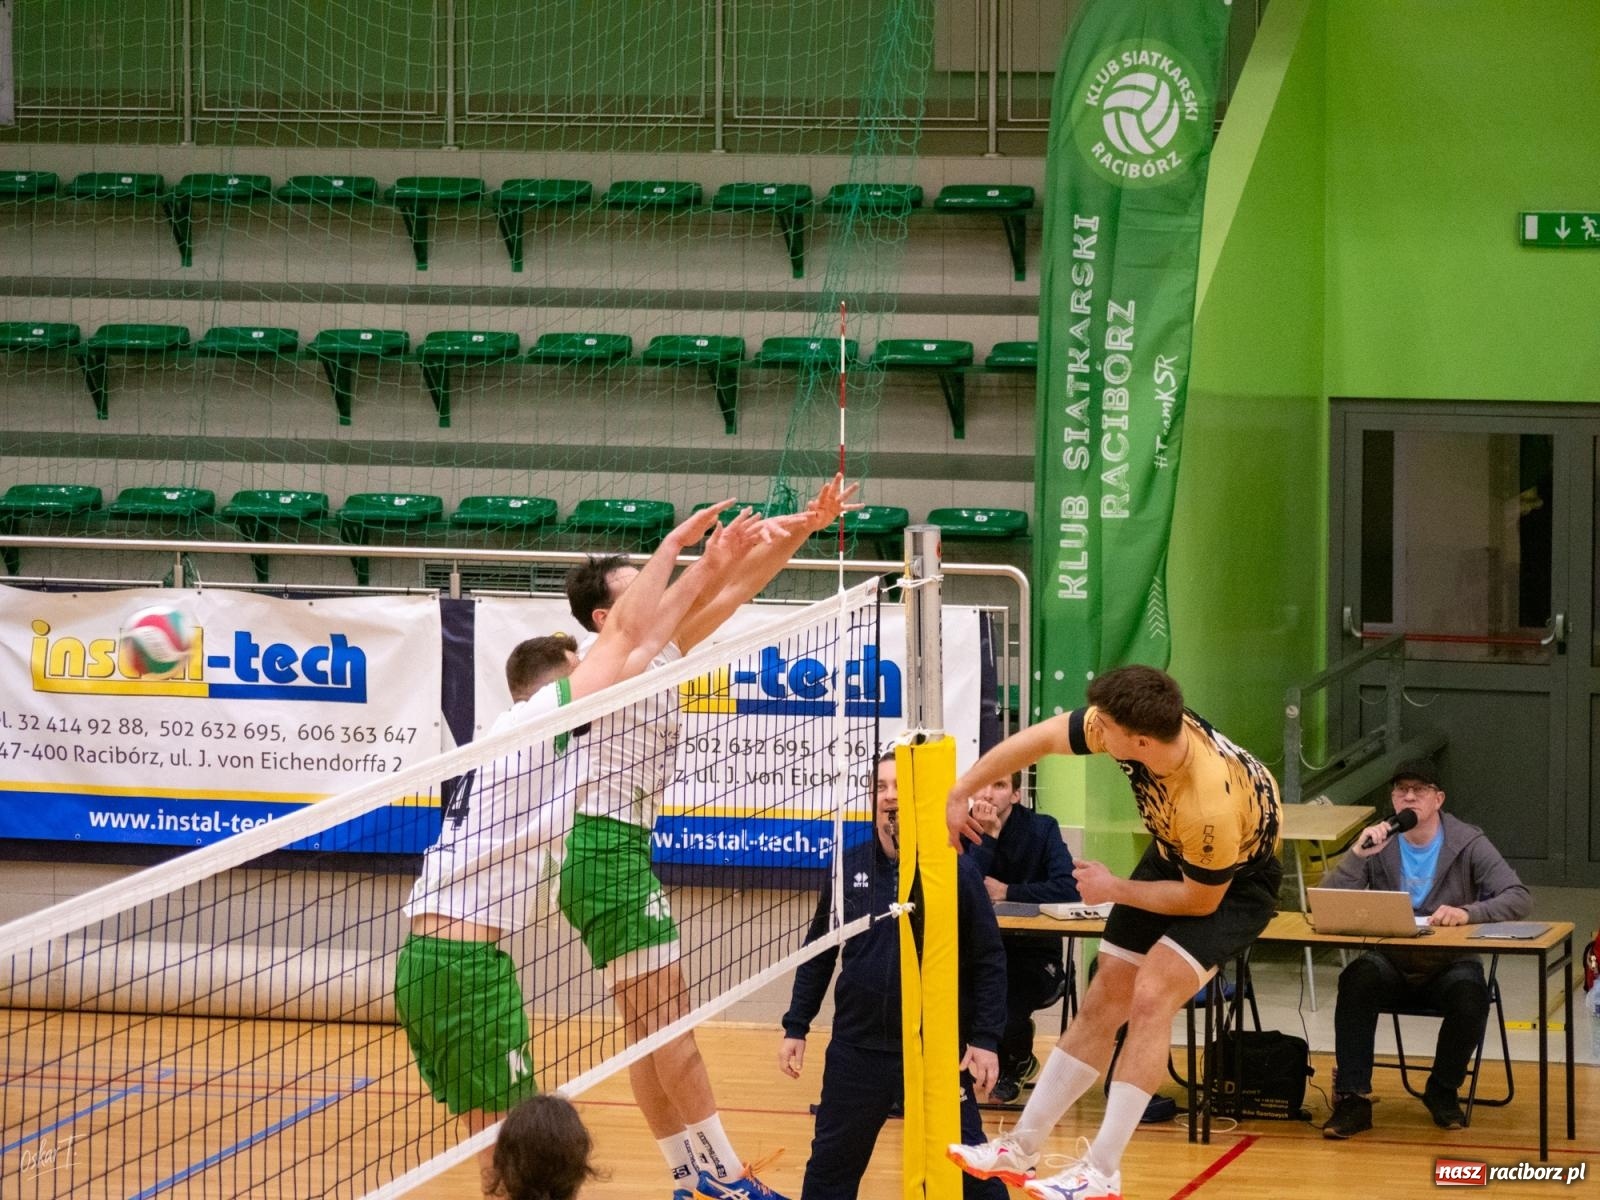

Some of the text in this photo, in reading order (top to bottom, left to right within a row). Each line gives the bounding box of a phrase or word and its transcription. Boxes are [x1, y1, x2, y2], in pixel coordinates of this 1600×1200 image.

[1085, 50, 1198, 121] KLUB SIATKARSKI
[1091, 141, 1182, 179] RACIBÓRZ
[1058, 213, 1100, 600] KLUB SIATKARSKI
[1096, 299, 1135, 519] RACIBÓRZ
[18, 714, 40, 730] 32
[46, 716, 82, 734] 414
[87, 718, 112, 735] 92
[118, 718, 148, 738] 88,
[159, 720, 194, 738] 502
[201, 721, 236, 739] 632
[243, 723, 287, 743] 695,
[298, 724, 335, 742] 606
[341, 726, 377, 744] 363
[384, 725, 417, 744] 647
[74, 745, 164, 768] Racibórz,
[170, 748, 192, 767] ul.
[199, 750, 211, 768] J.
[218, 755, 254, 769] von
[261, 752, 386, 773] Eichendorffa
[392, 757, 402, 772] 2
[686, 737, 721, 754] 502
[729, 737, 766, 756] 632
[746, 771, 784, 785] von
